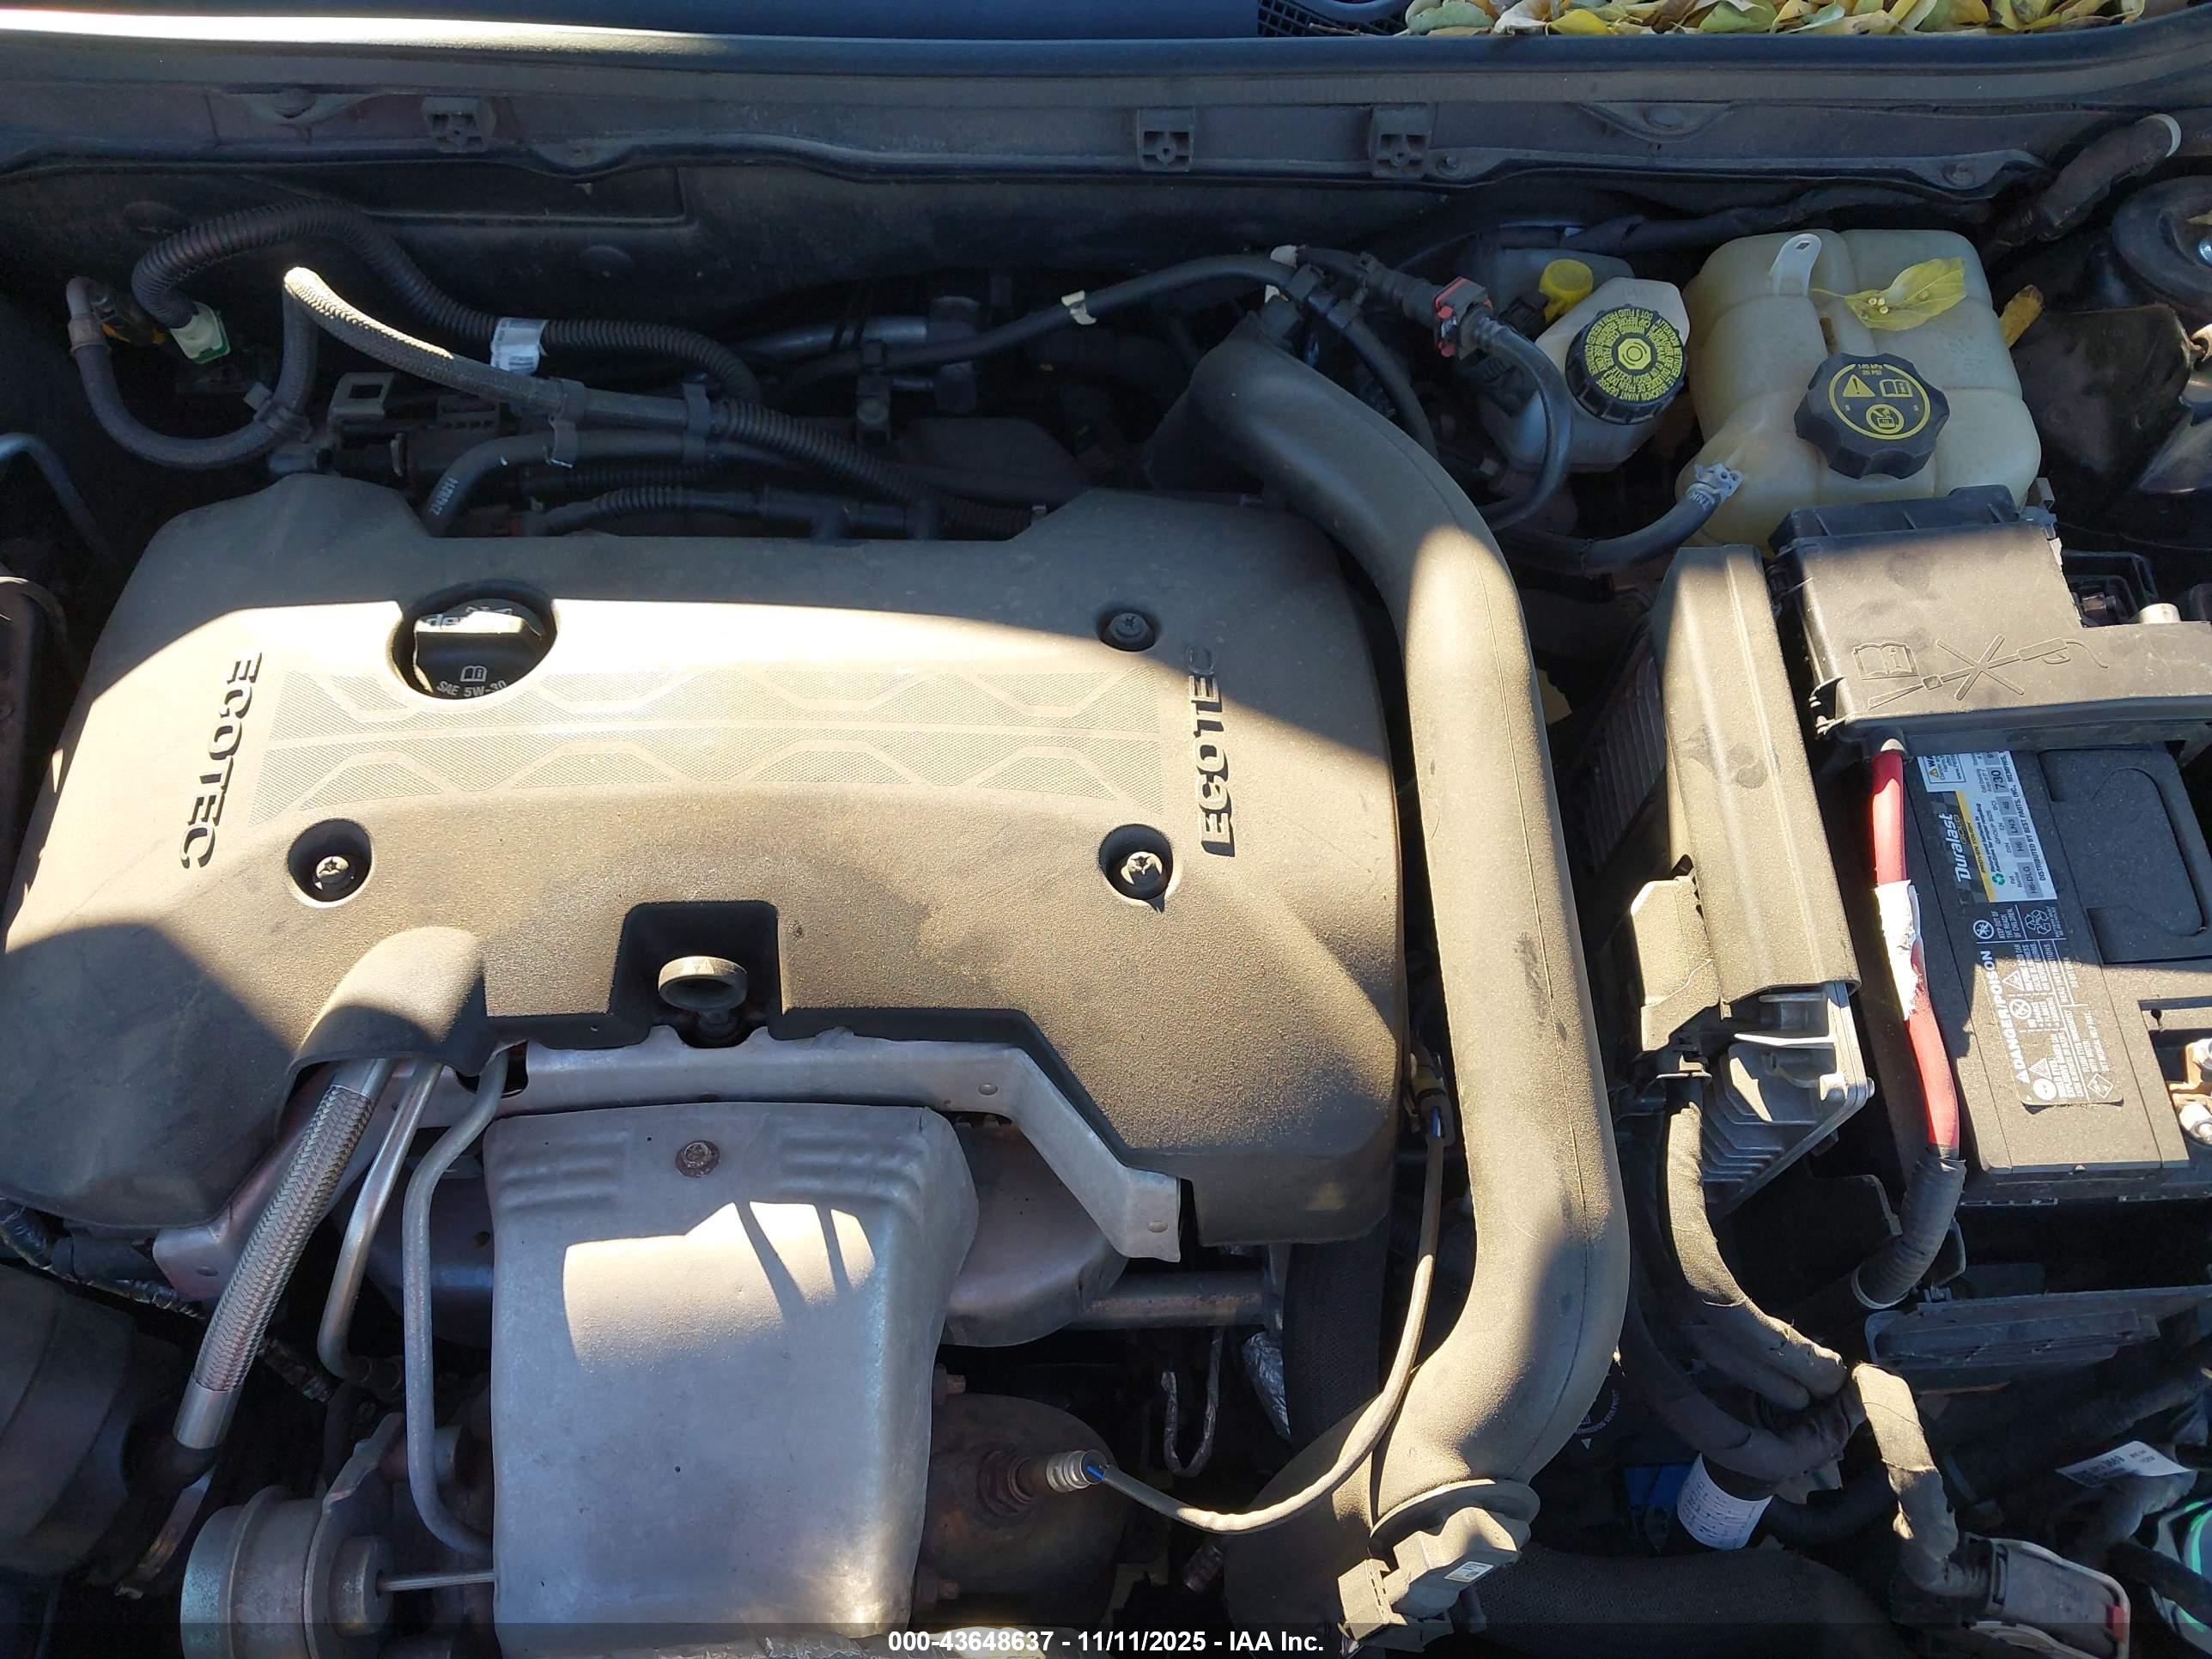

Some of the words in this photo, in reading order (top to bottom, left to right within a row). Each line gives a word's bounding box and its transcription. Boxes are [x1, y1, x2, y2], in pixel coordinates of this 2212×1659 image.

[1616, 307, 1634, 319] FLUID
[1640, 310, 1654, 320] DOT
[1654, 316, 1680, 346] ATTENTION
[1668, 346, 1684, 378] NETTOYER
[1606, 374, 1620, 386] DOT
[1636, 382, 1646, 392] DE
[1619, 391, 1640, 401] AVANT
[436, 681, 461, 696] SAE
[1185, 645, 1234, 854] ECOTEC
[179, 651, 262, 869] ECOTEC
[1990, 769, 2006, 789] 730
[1990, 799, 1998, 810] BCI
[1984, 809, 1994, 822] SIZE
[1952, 813, 1968, 844] GOLD
[1966, 821, 1978, 844] TOUGH
[1996, 822, 2005, 830] EN
[2007, 818, 2019, 834] LN3
[2020, 818, 2031, 833] BEST
[1989, 823, 2002, 844] GROUP
[2025, 834, 2034, 842] BY
[1936, 811, 1973, 882] Duralast
[2003, 842, 2012, 853] DIN
[2014, 841, 2025, 852] H6
[1972, 844, 1987, 873] PROVEN
[2027, 842, 2046, 881] DISTRIBUTED
[2021, 865, 2038, 893] H6-DLG
[2004, 929, 2014, 939] THE
[1978, 950, 2027, 1069] DANGER/POISON
